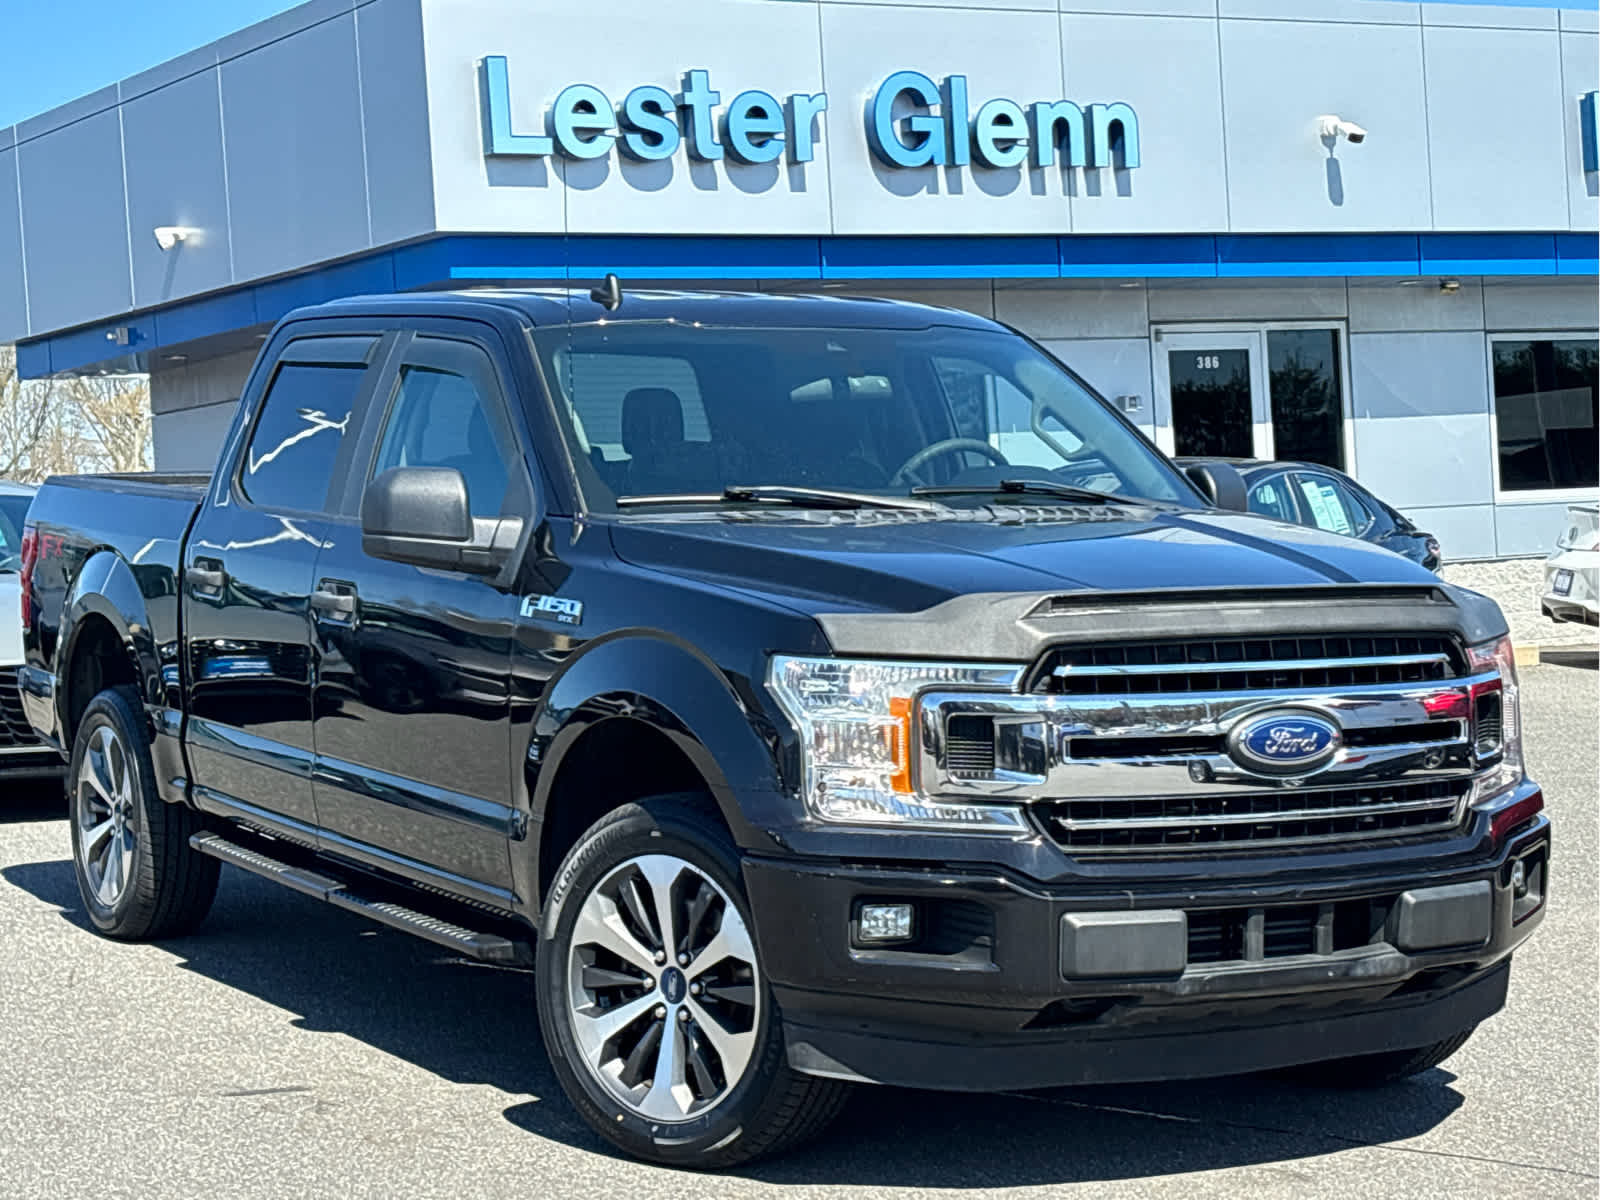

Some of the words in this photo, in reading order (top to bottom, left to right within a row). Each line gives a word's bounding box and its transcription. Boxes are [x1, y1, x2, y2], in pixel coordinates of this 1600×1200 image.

[479, 55, 828, 164] Lester
[865, 70, 1140, 169] Glenn
[1196, 355, 1220, 369] 386
[1264, 726, 1318, 754] Ford
